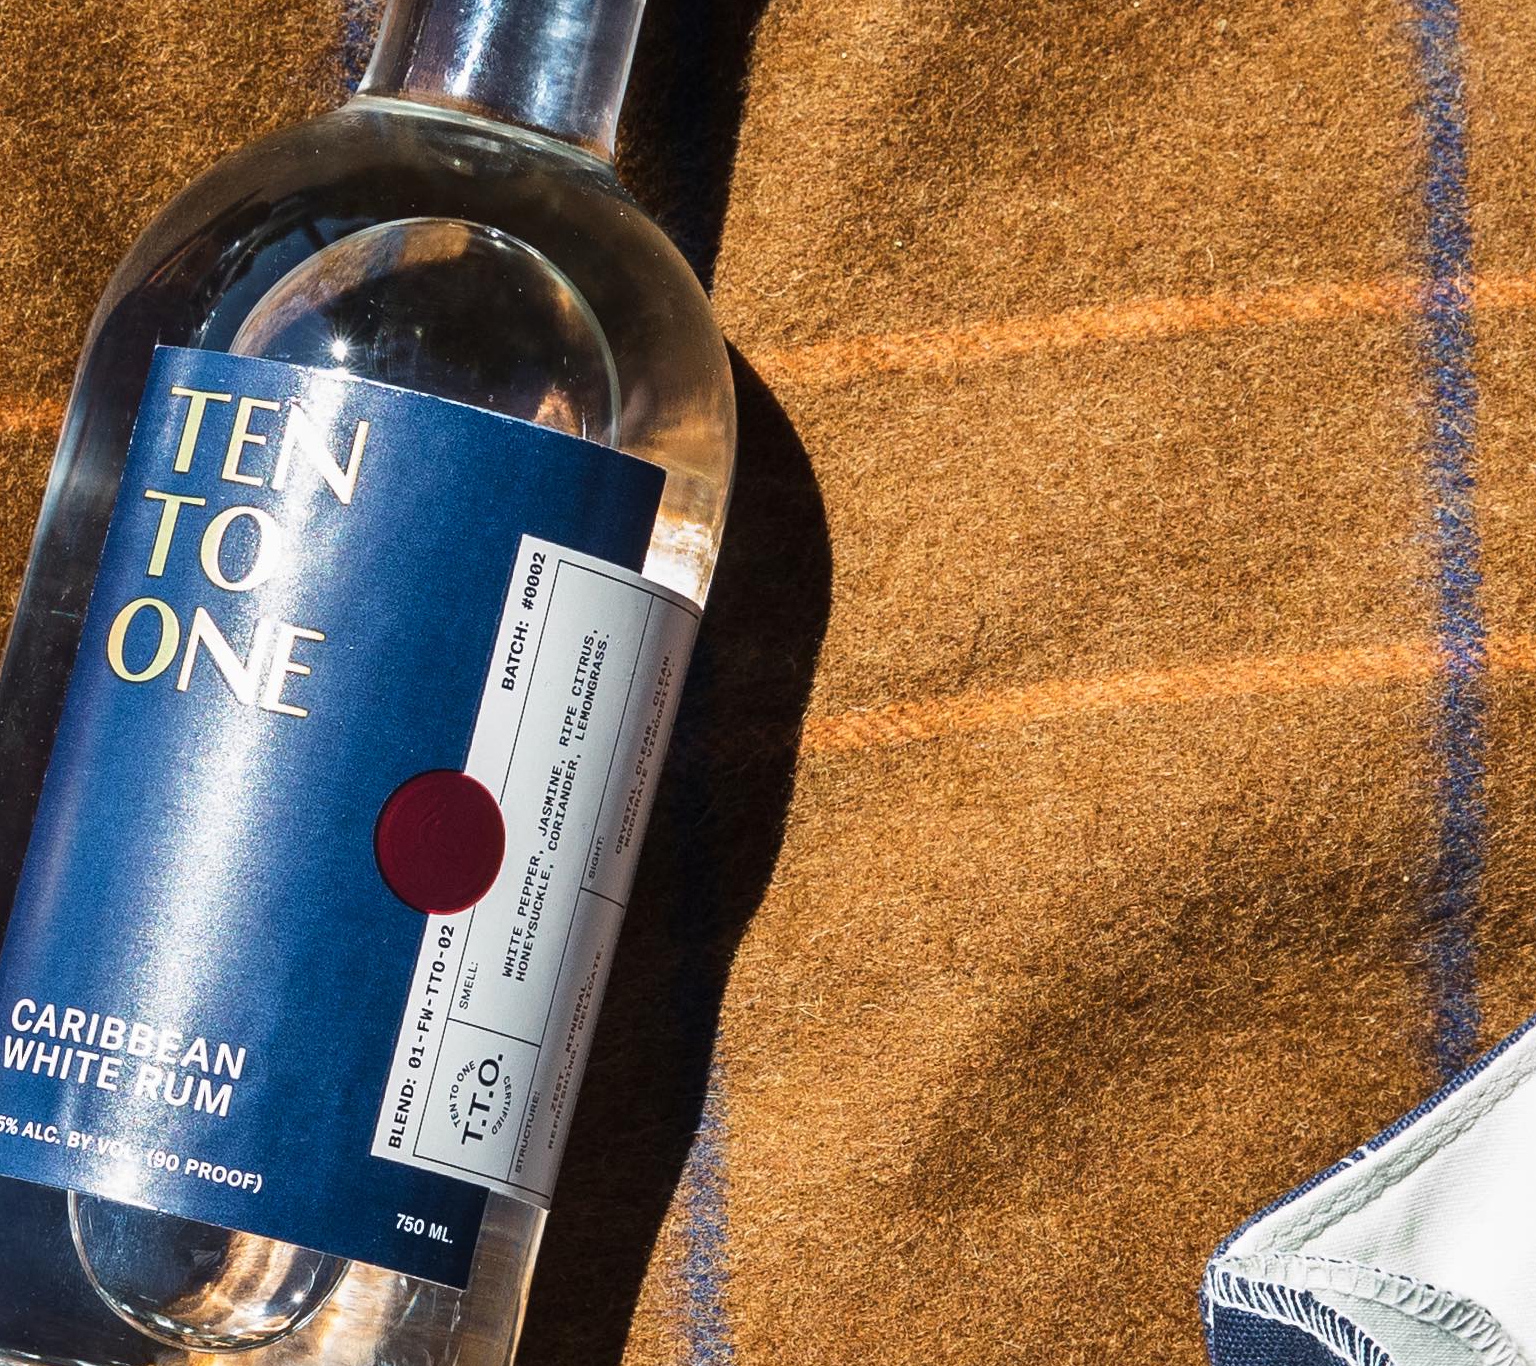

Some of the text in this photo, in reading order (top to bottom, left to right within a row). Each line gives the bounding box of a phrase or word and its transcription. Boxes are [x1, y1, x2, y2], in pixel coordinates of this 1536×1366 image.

[171, 386, 370, 505] TEN
[144, 489, 284, 593] TO
[107, 597, 325, 718] ONE
[501, 552, 547, 691] BATCH: #0002
[501, 629, 599, 978] WHITE PEPPER, JASMINE, RIPE CITRUS,
[515, 634, 610, 982] HONEYSUCKLE, CORIANDER, LEMONGRASS.
[588, 835, 605, 880] SIGHT:
[459, 962, 479, 1010] SMELL:
[2, 1034, 234, 1119] WHITE RUM
[11, 998, 247, 1080] CARIBBEAN
[387, 925, 455, 1149] BLEND: 01-FW-TTO-02
[450, 1061, 475, 1128] TEN TO ONE
[461, 1053, 504, 1145] T.T.O.
[491, 1075, 512, 1135] CERTIFIED
[514, 1091, 541, 1174] STRUCTURE:
[20, 1120, 62, 1145] ALC.
[66, 1130, 95, 1151] BY
[146, 1148, 181, 1172] (90
[184, 1157, 264, 1195] PROOF)
[395, 1212, 454, 1245] 750 ML.
